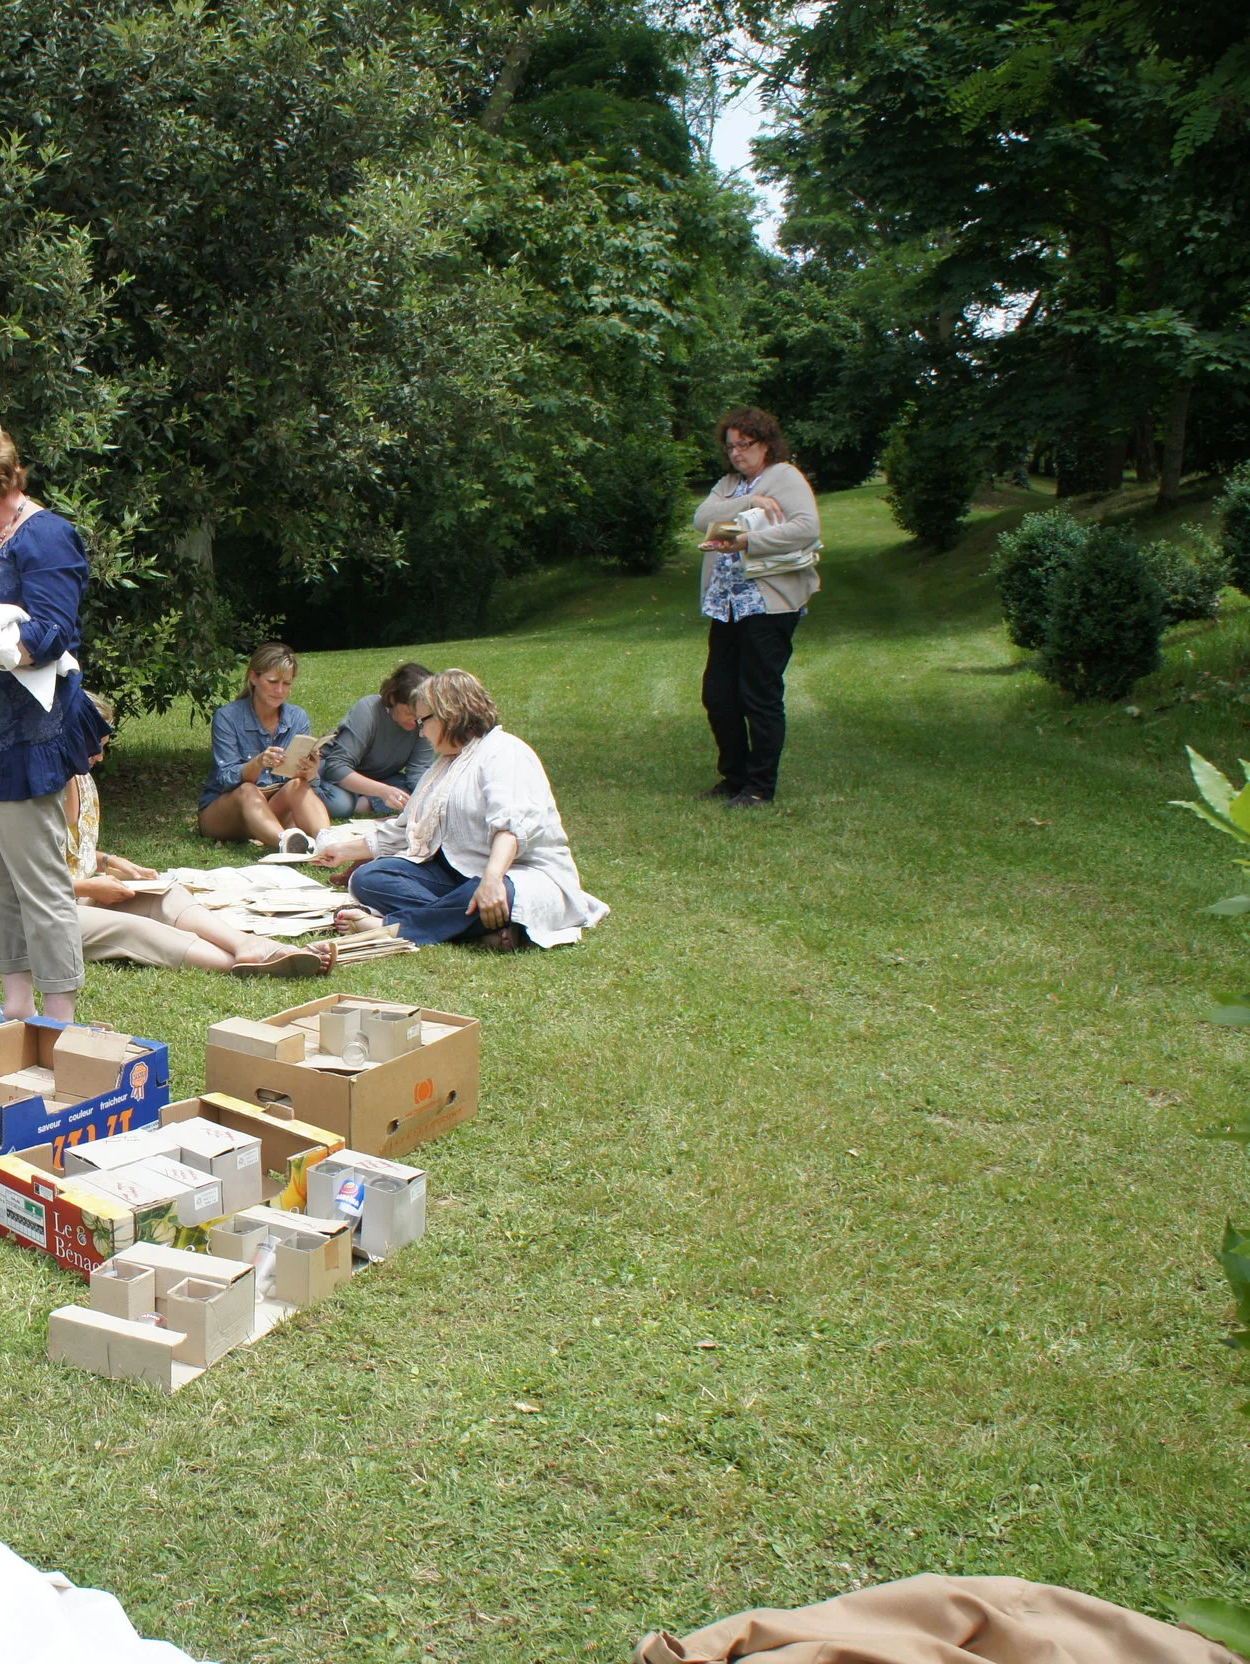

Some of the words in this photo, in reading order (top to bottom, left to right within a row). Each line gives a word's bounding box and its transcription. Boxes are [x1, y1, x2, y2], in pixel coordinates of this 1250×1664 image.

[37, 1119, 62, 1134] saveur
[68, 1107, 94, 1123] couleur
[53, 1211, 73, 1239] Le
